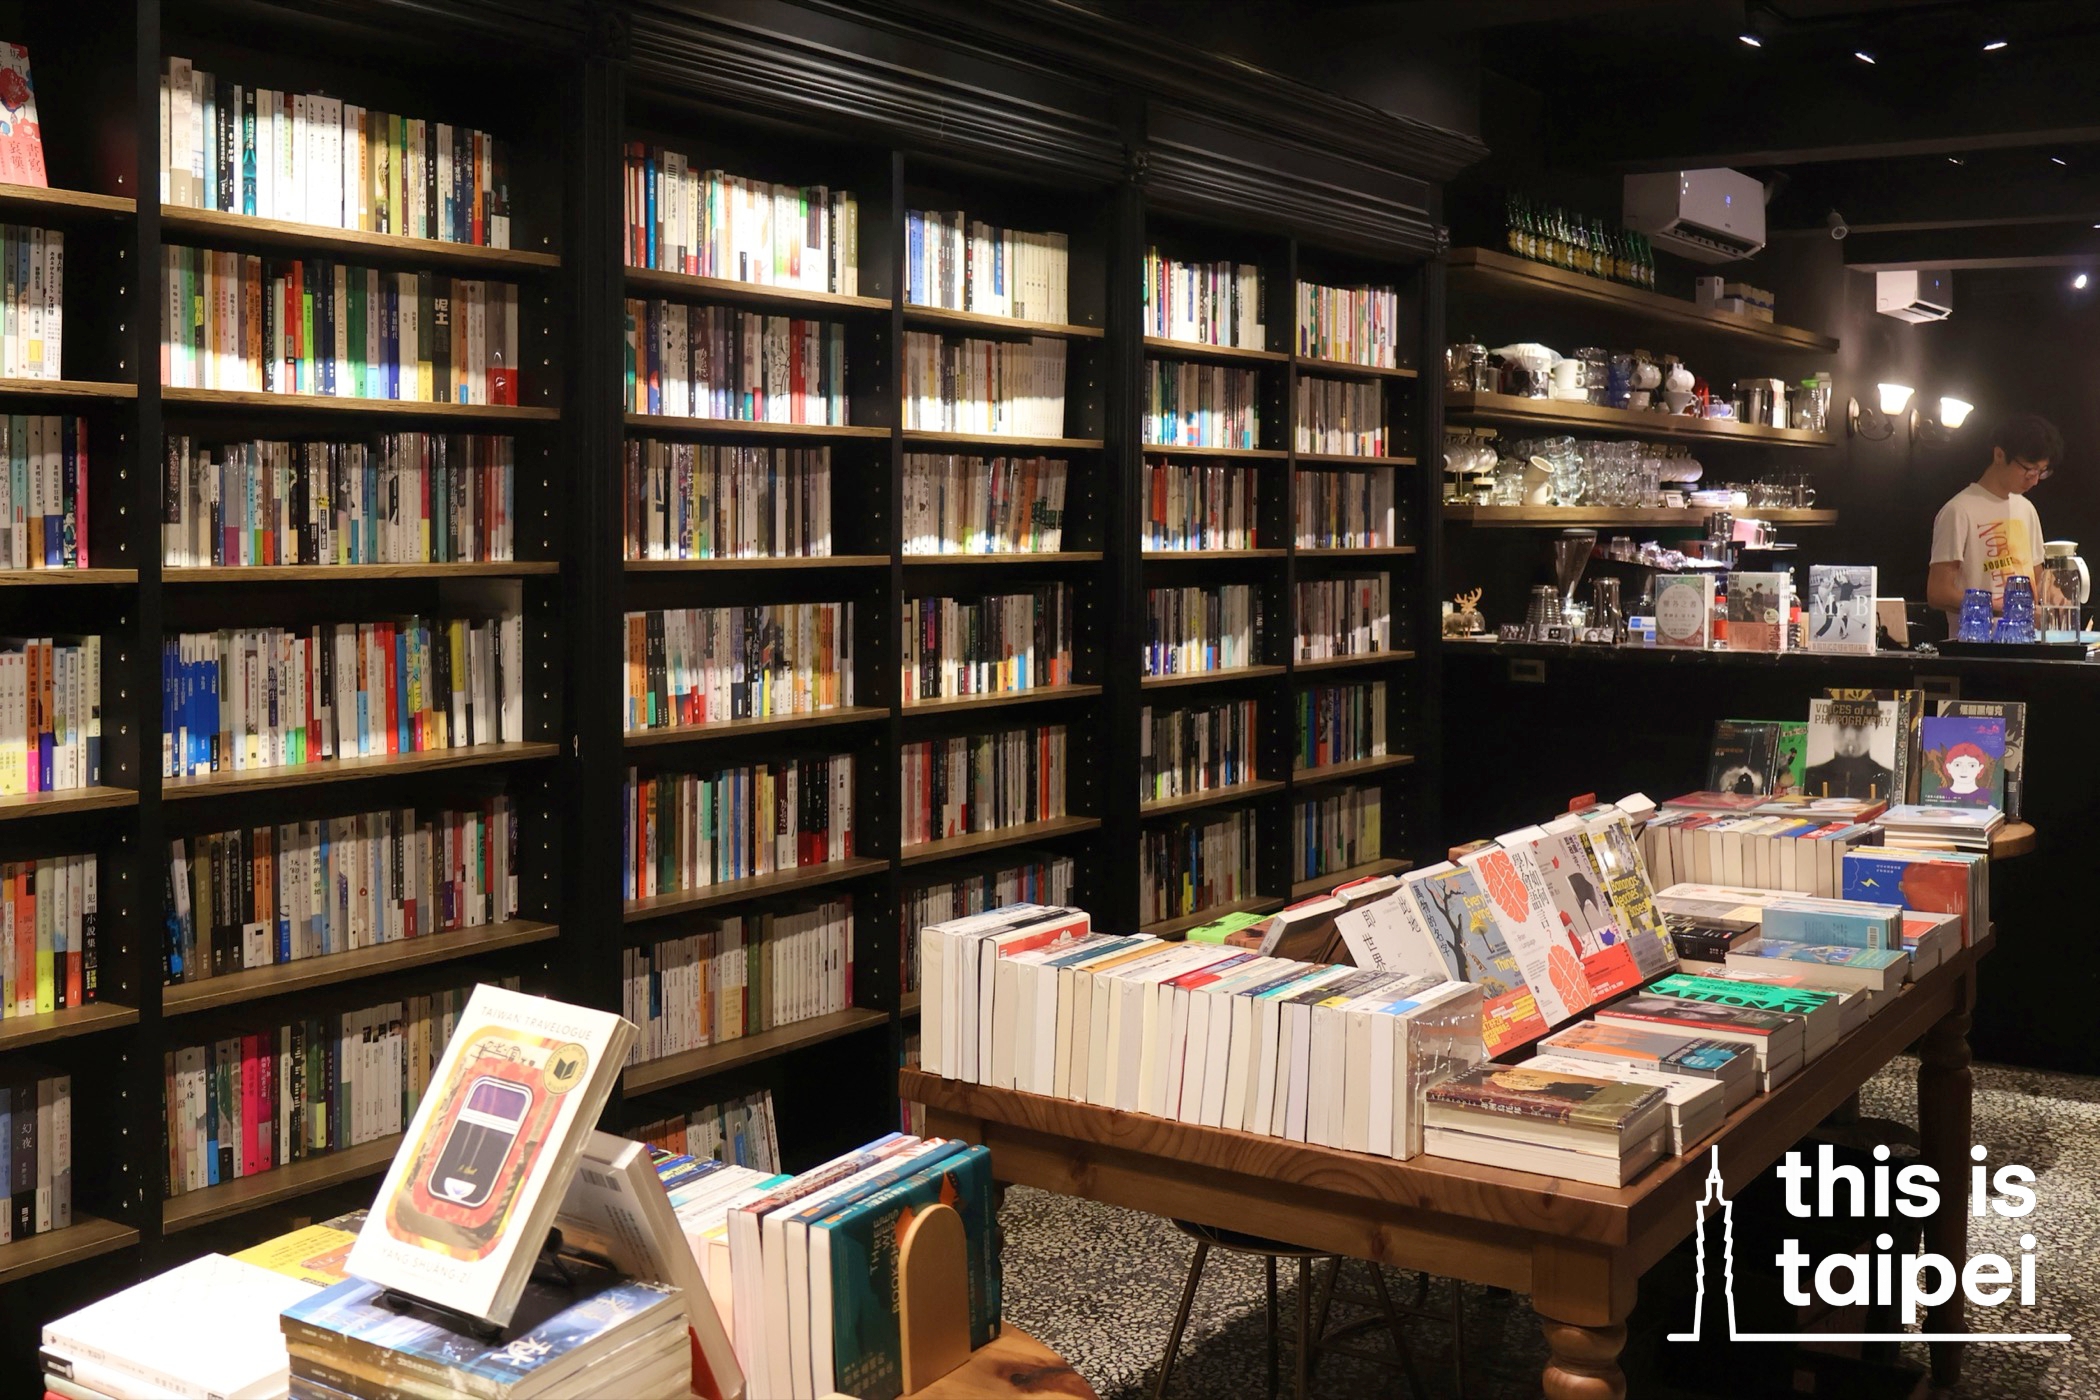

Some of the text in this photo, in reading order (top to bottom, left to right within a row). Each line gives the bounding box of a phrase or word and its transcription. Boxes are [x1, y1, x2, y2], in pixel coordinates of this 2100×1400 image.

[434, 298, 449, 326] 泥土
[1815, 703, 1850, 716] VOICES
[1854, 704, 1865, 716] of
[1462, 893, 1486, 909] Every
[86, 893, 97, 949] 犯罪小說集
[480, 1005, 593, 1041] TAIWAN TRAVELOGUE
[21, 1123, 33, 1149] 幻夜
[869, 1219, 881, 1276] THREE
[889, 1208, 901, 1315] BOOKSHOPS
